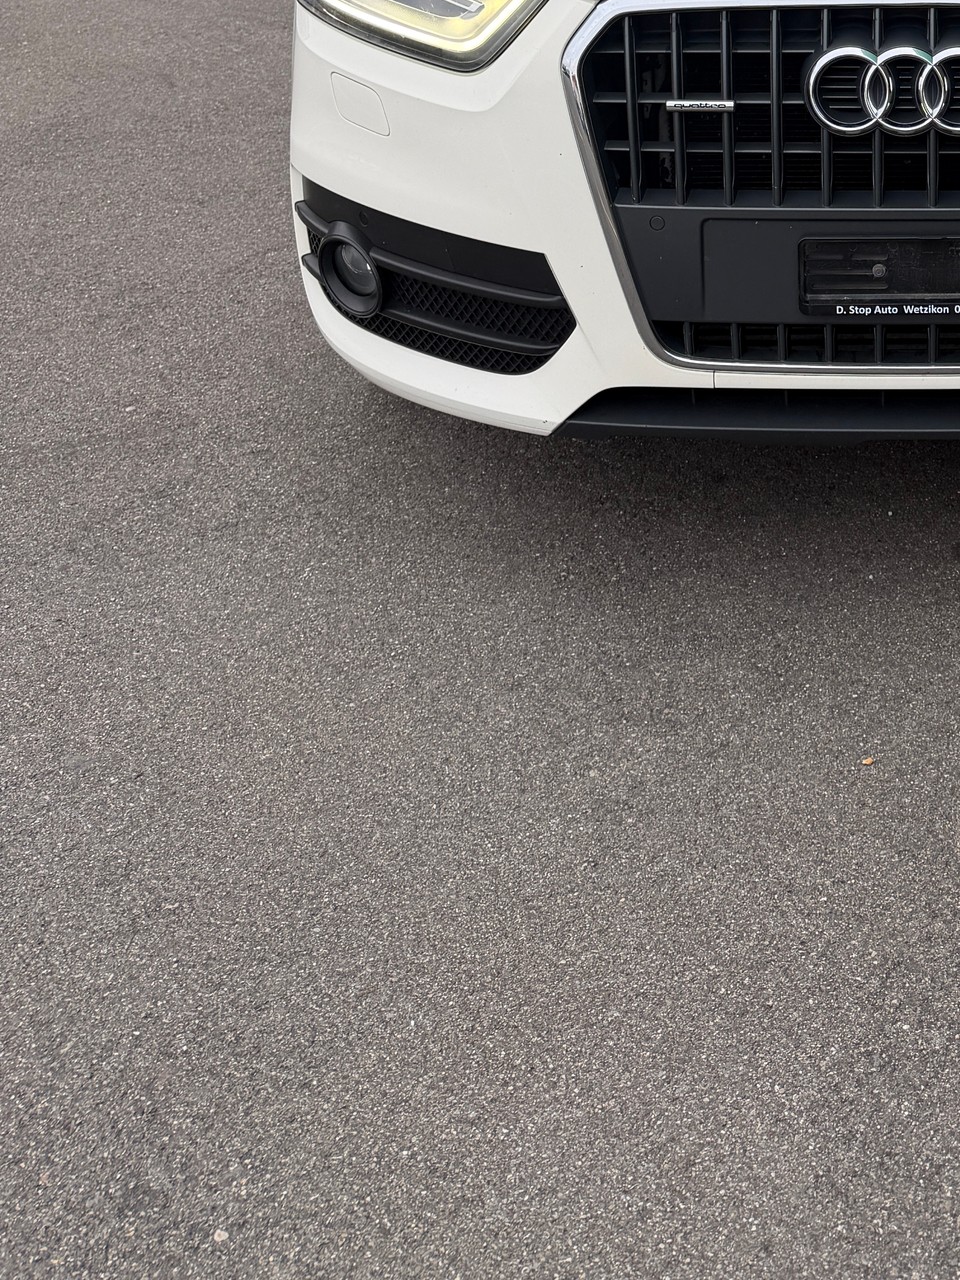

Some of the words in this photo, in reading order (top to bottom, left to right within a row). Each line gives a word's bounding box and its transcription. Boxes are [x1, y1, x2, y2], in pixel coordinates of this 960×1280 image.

[836, 305, 847, 315] D.
[849, 304, 872, 316] Stop
[873, 305, 899, 314] Auto
[903, 304, 950, 315] Wetzikon
